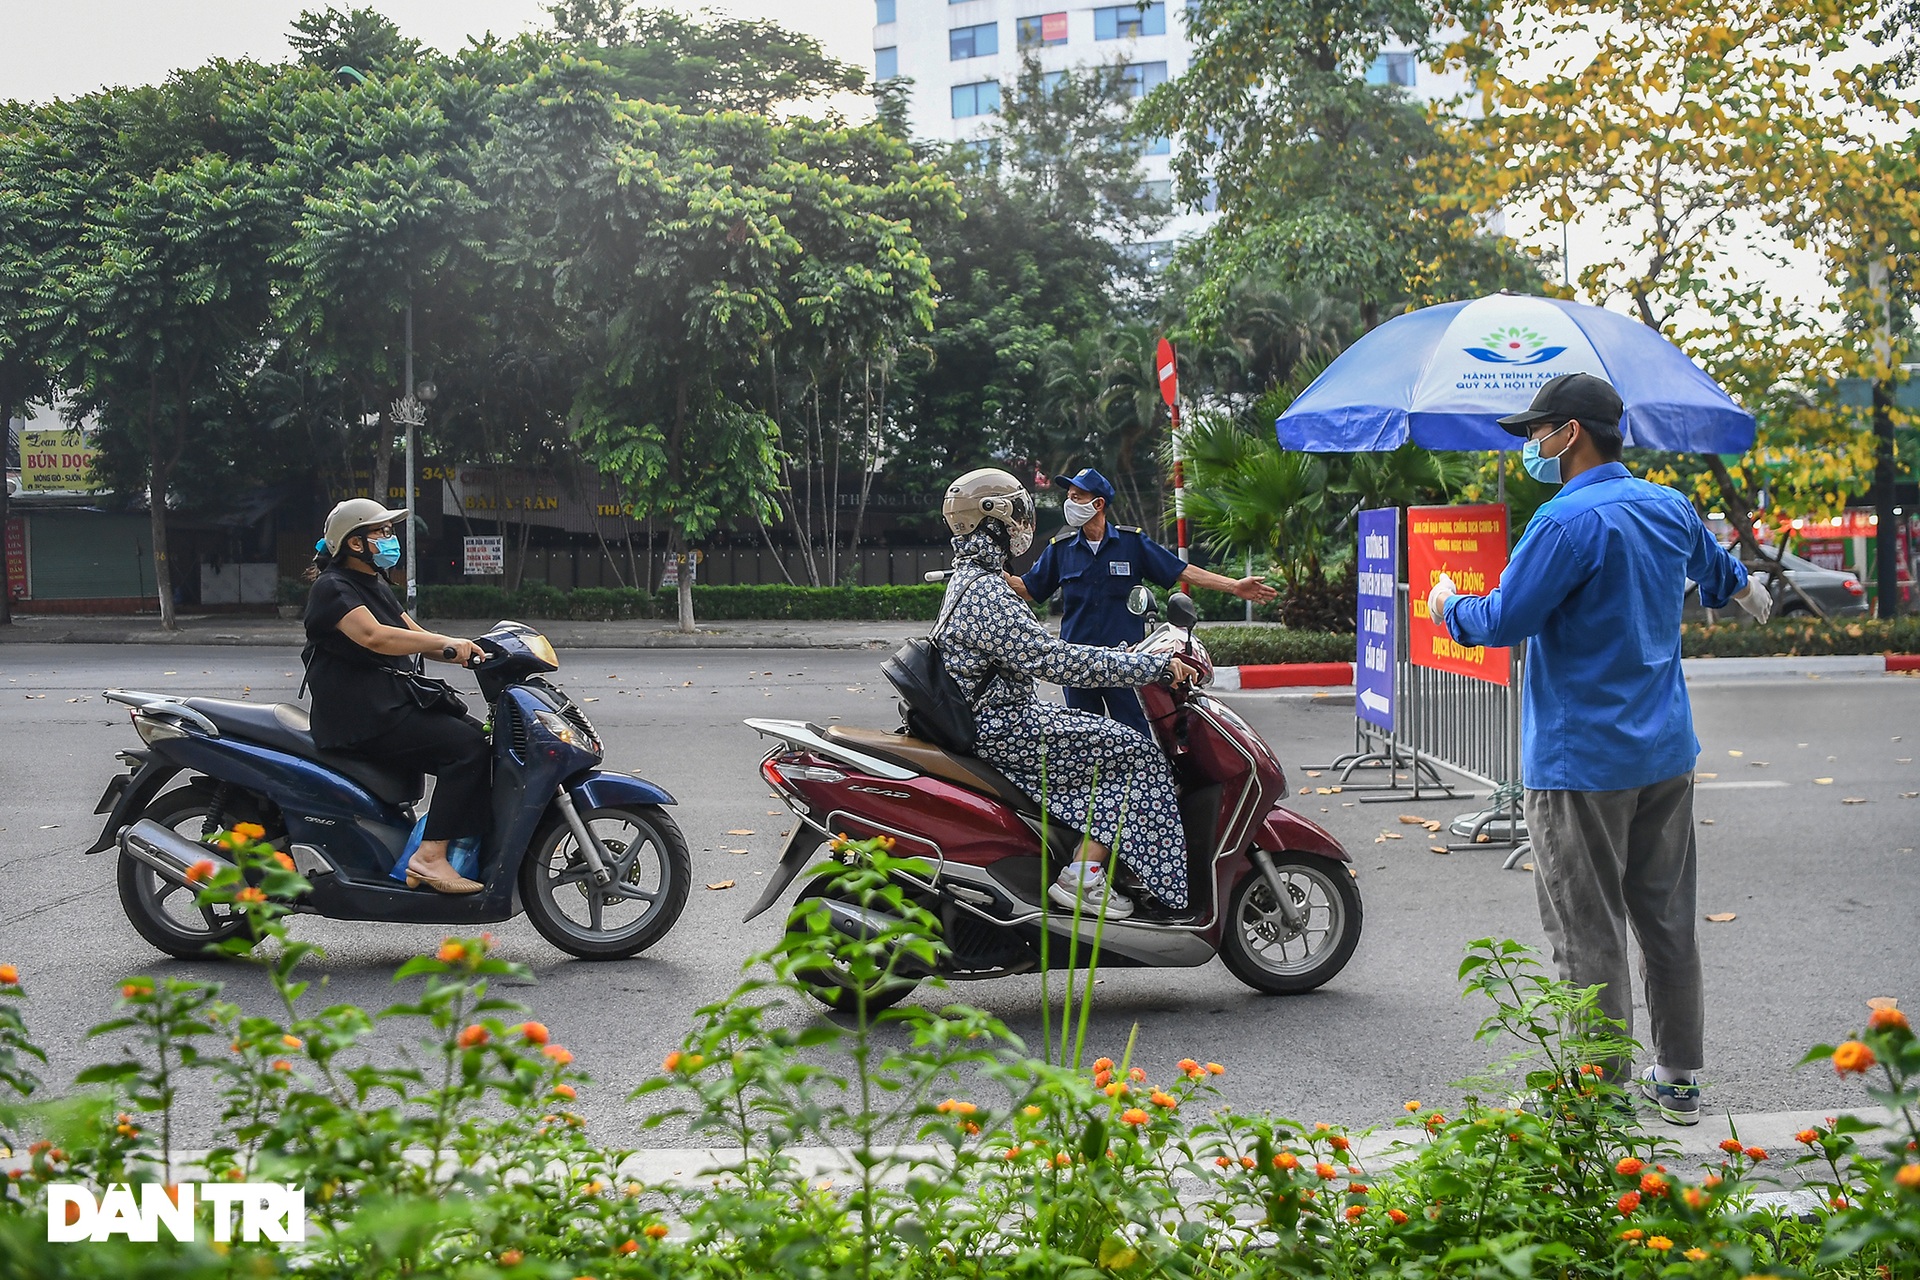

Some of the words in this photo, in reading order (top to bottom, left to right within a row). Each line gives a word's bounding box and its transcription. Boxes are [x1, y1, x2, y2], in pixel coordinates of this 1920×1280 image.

[1462, 371, 1496, 380] HÀNH
[1500, 371, 1533, 380] TRÌNH
[1537, 371, 1570, 379] XAN
[1503, 381, 1525, 391] HỘI
[27, 450, 58, 468] BÚN
[61, 453, 92, 472] DỌC
[1432, 636, 1450, 660] DỊCH
